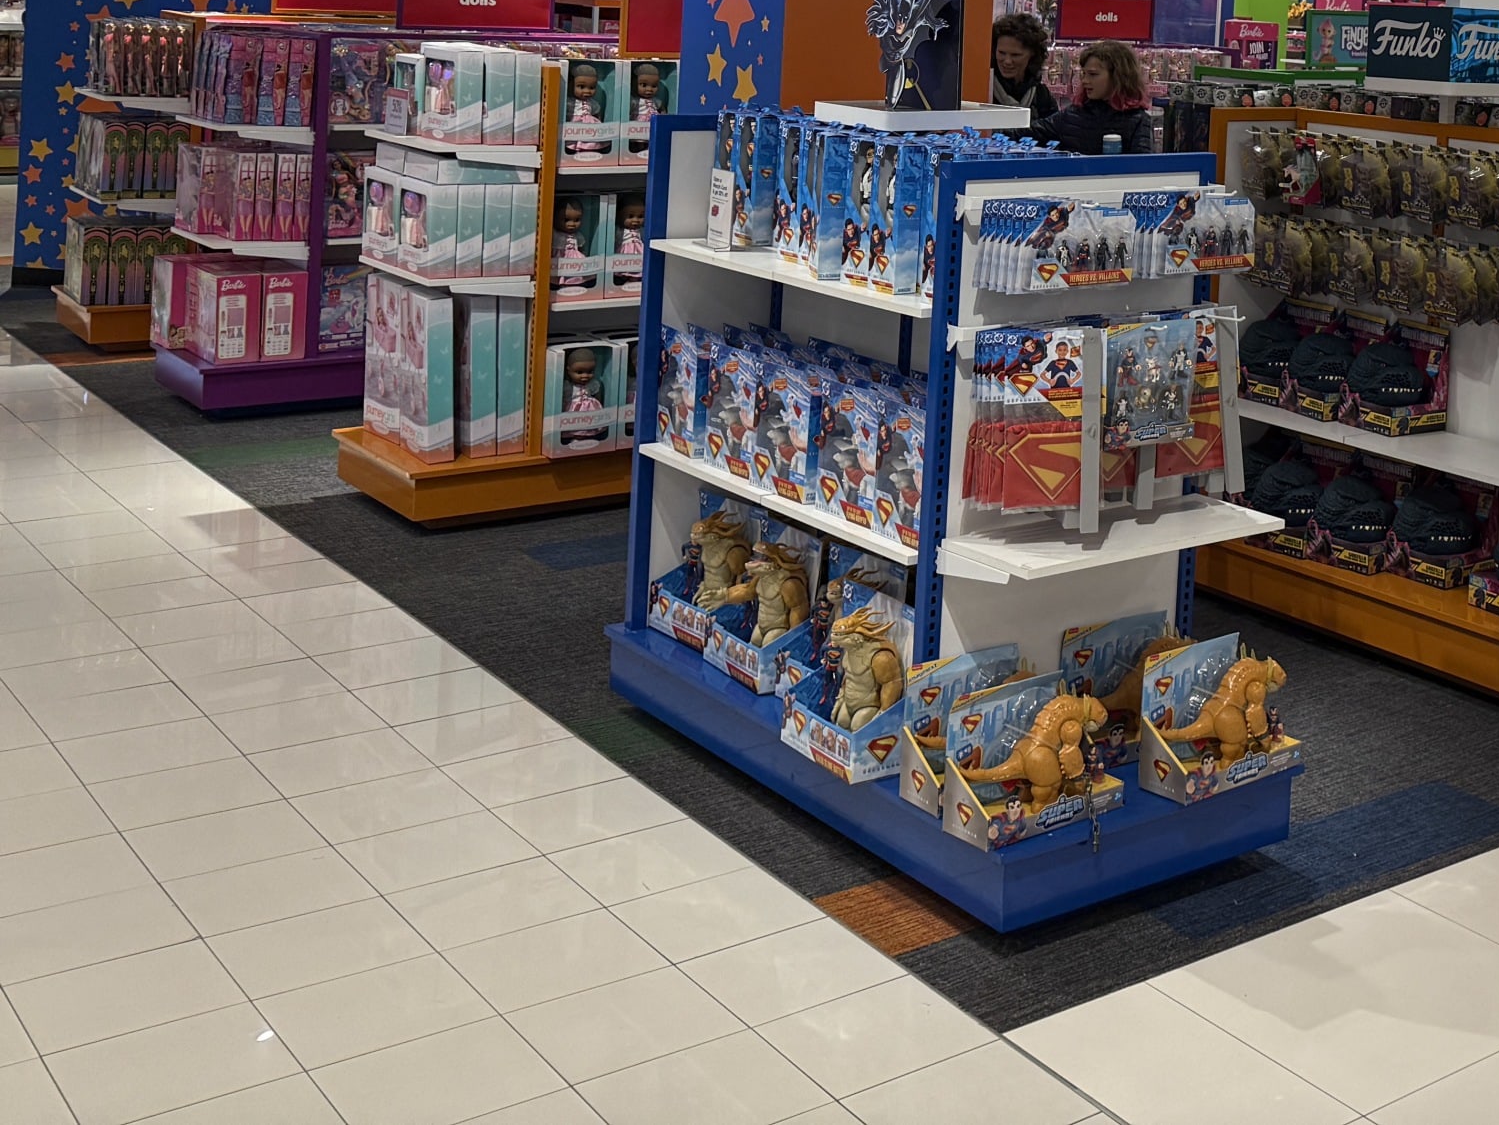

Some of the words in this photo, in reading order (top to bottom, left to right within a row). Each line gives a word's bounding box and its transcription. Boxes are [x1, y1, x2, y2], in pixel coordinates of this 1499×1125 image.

[1095, 12, 1119, 23] dolls
[1240, 24, 1265, 37] Barbie
[1371, 19, 1447, 59] Funko
[551, 259, 600, 271] ourneygirls
[612, 258, 642, 270] journey
[221, 279, 247, 291] Barbie
[269, 277, 294, 289] Barbie
[1229, 756, 1268, 776] SUPER
[1039, 797, 1084, 818] SUPER
